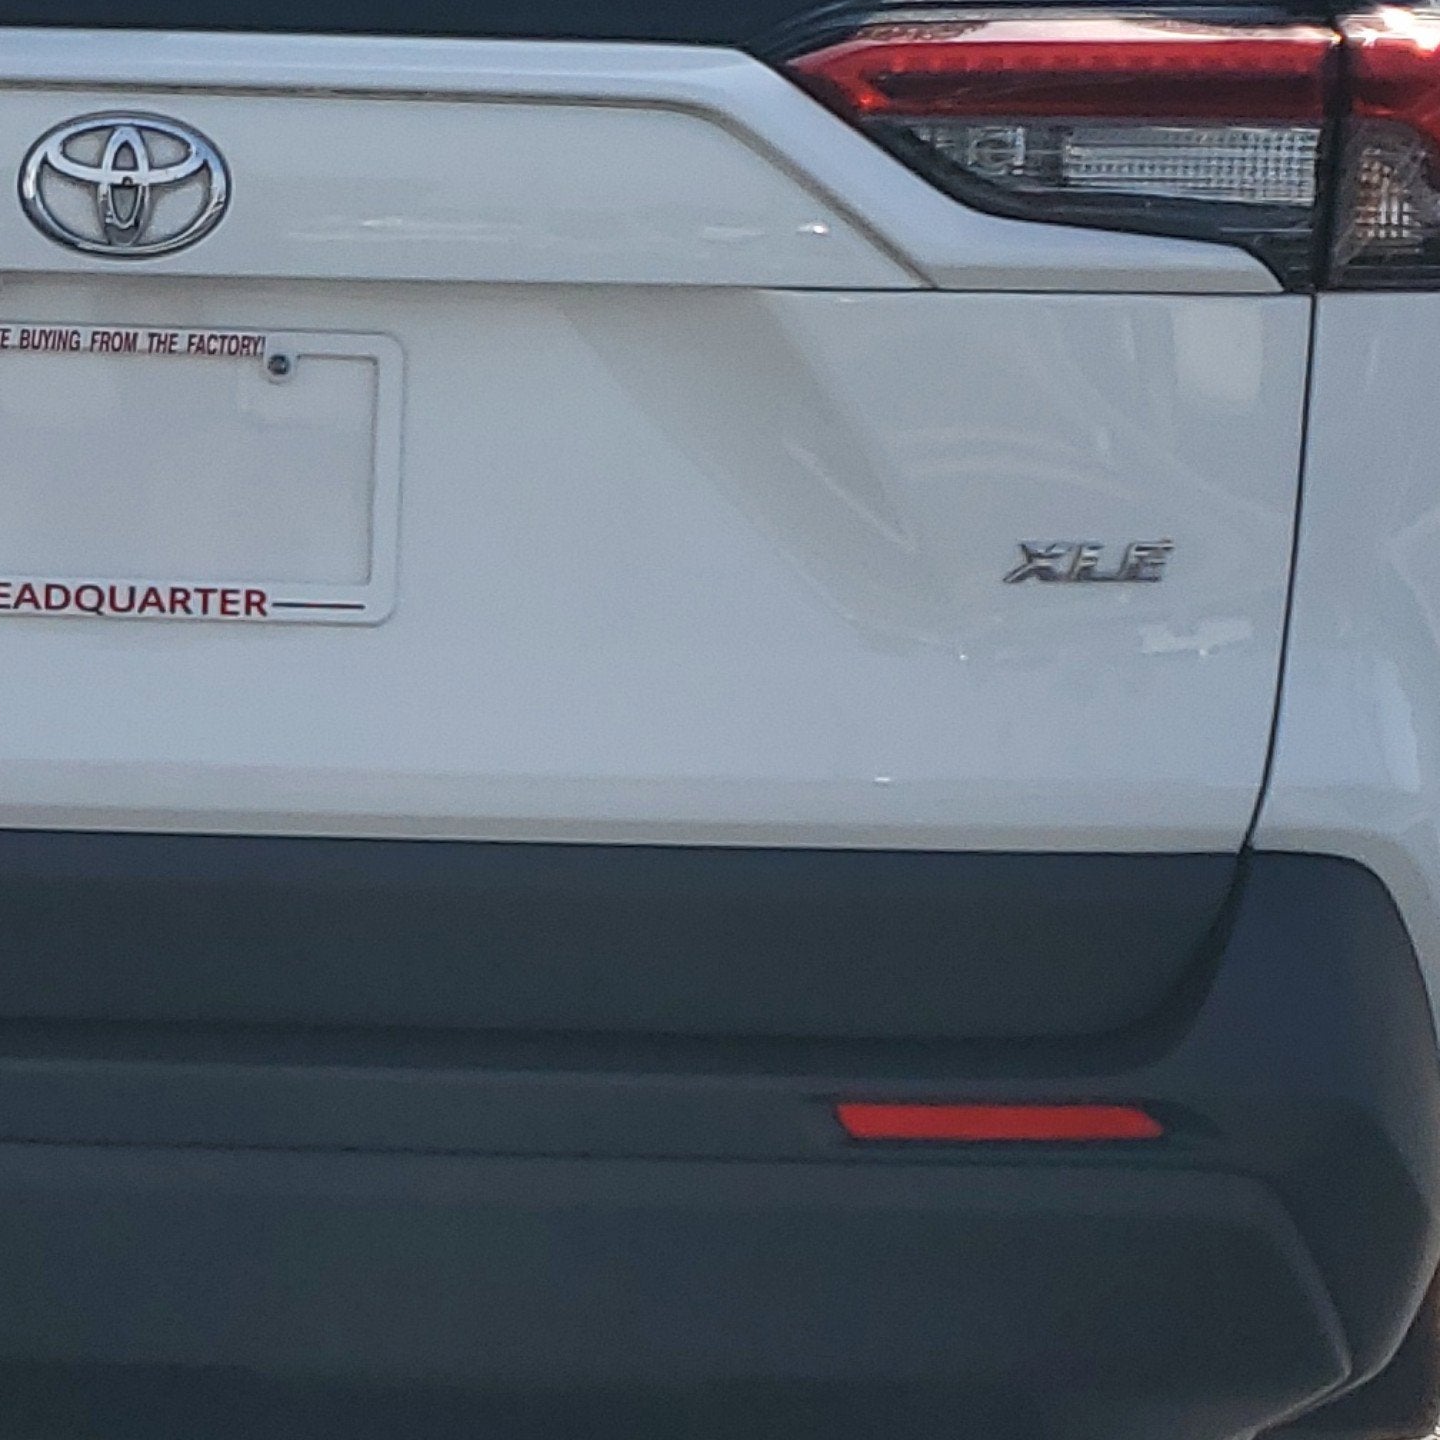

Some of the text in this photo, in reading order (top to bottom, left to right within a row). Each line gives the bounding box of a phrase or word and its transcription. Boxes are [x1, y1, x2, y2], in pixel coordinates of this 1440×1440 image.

[19, 328, 81, 351] BUYING
[89, 330, 138, 353] FROM
[147, 332, 179, 354] THE
[186, 334, 267, 357] FACTORY!
[1003, 539, 1175, 583] XLE
